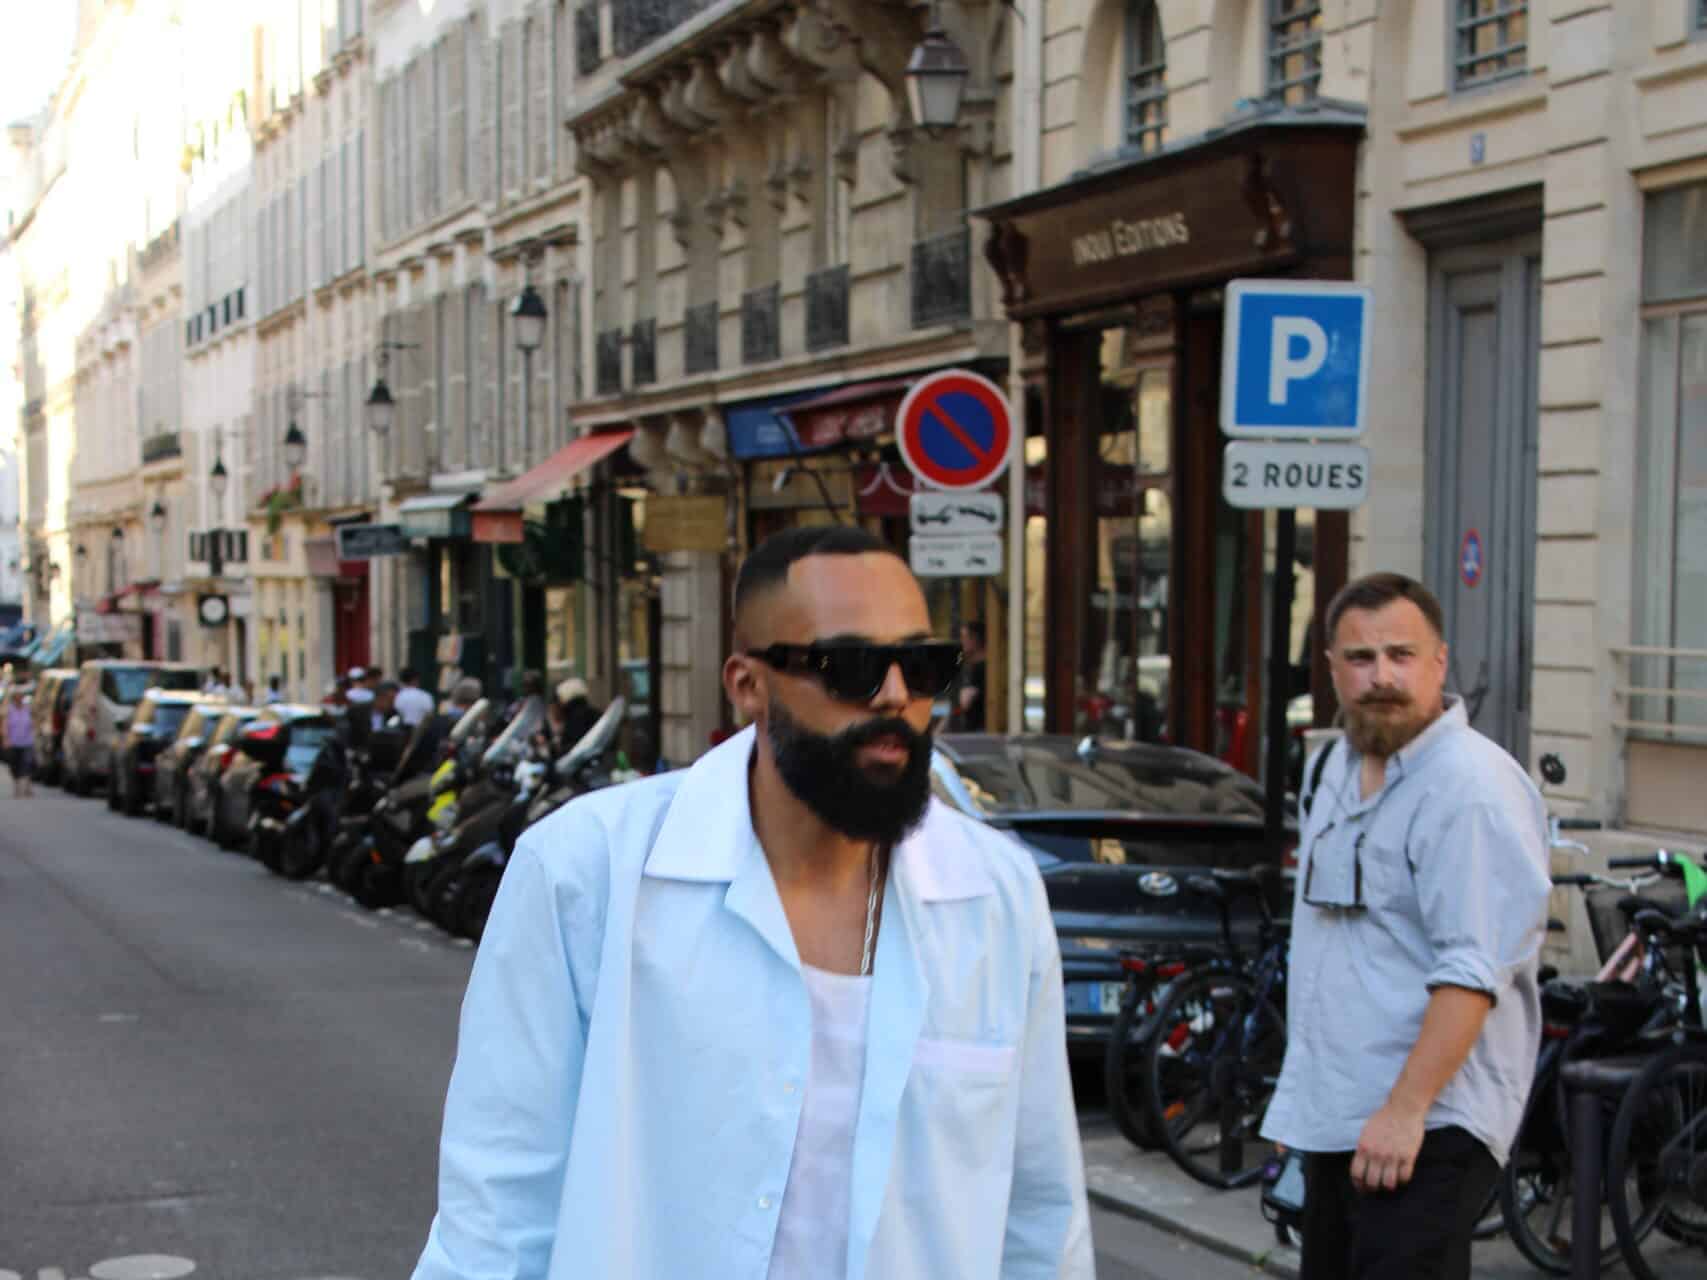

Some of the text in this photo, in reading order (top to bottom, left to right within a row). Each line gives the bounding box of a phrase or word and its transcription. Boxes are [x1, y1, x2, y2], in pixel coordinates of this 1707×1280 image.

[1269, 315, 1328, 405] P
[1232, 461, 1364, 489] 2 ROUES
